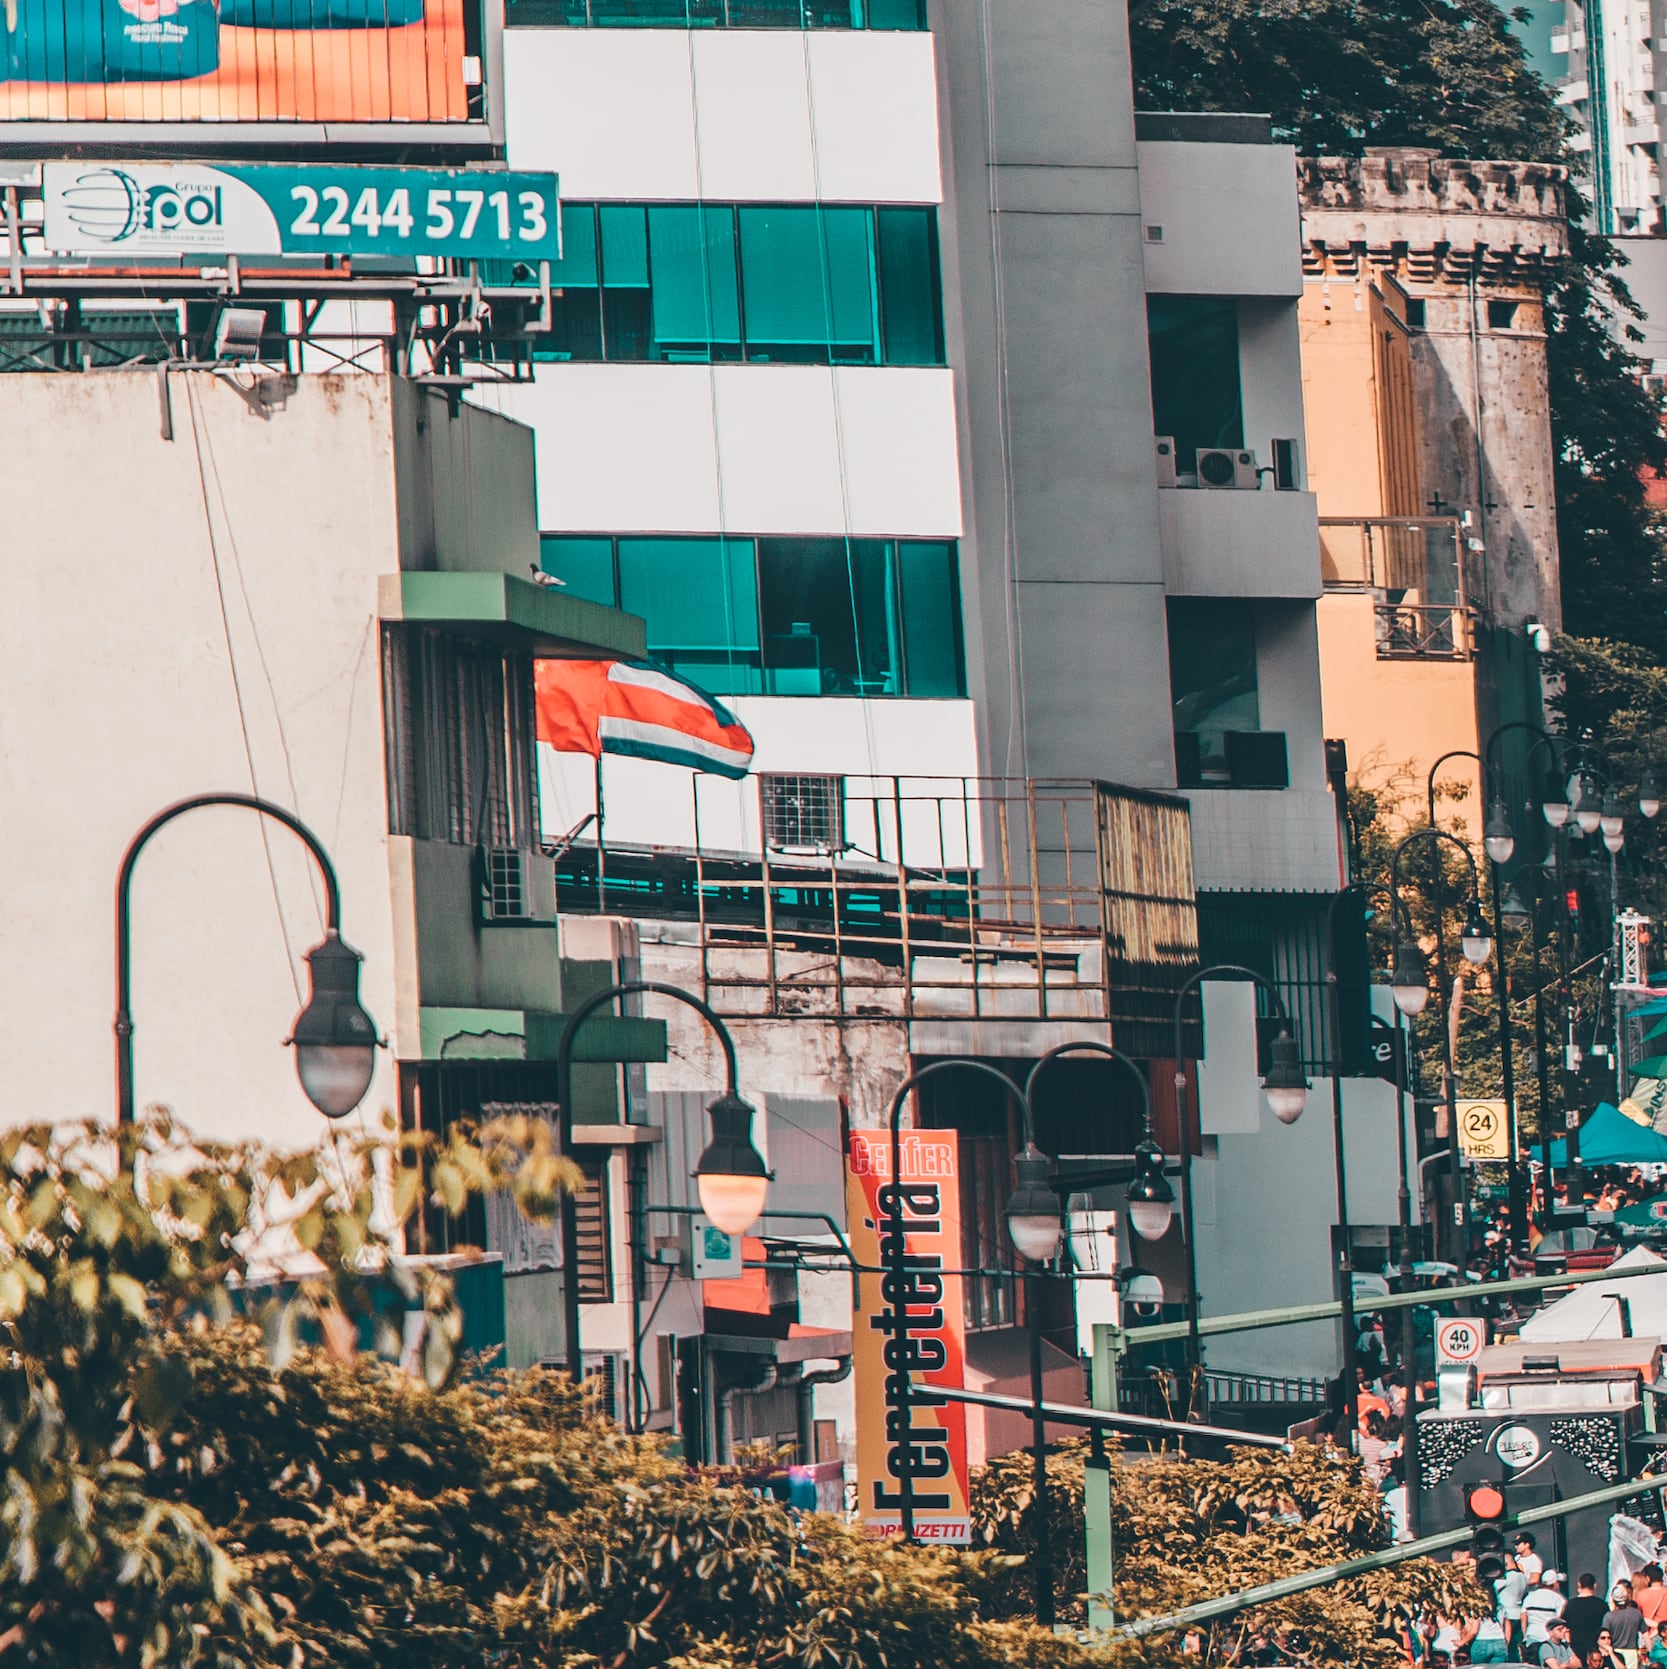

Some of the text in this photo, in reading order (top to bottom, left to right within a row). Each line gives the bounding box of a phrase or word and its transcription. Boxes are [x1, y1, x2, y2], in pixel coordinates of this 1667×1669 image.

[175, 182, 213, 194] Grupo
[291, 185, 547, 242] 2244 5713
[1469, 1114, 1492, 1131] 24
[1469, 1144, 1495, 1155] HRS
[1450, 1330, 1469, 1343] 40
[1449, 1343, 1470, 1351] KPH
